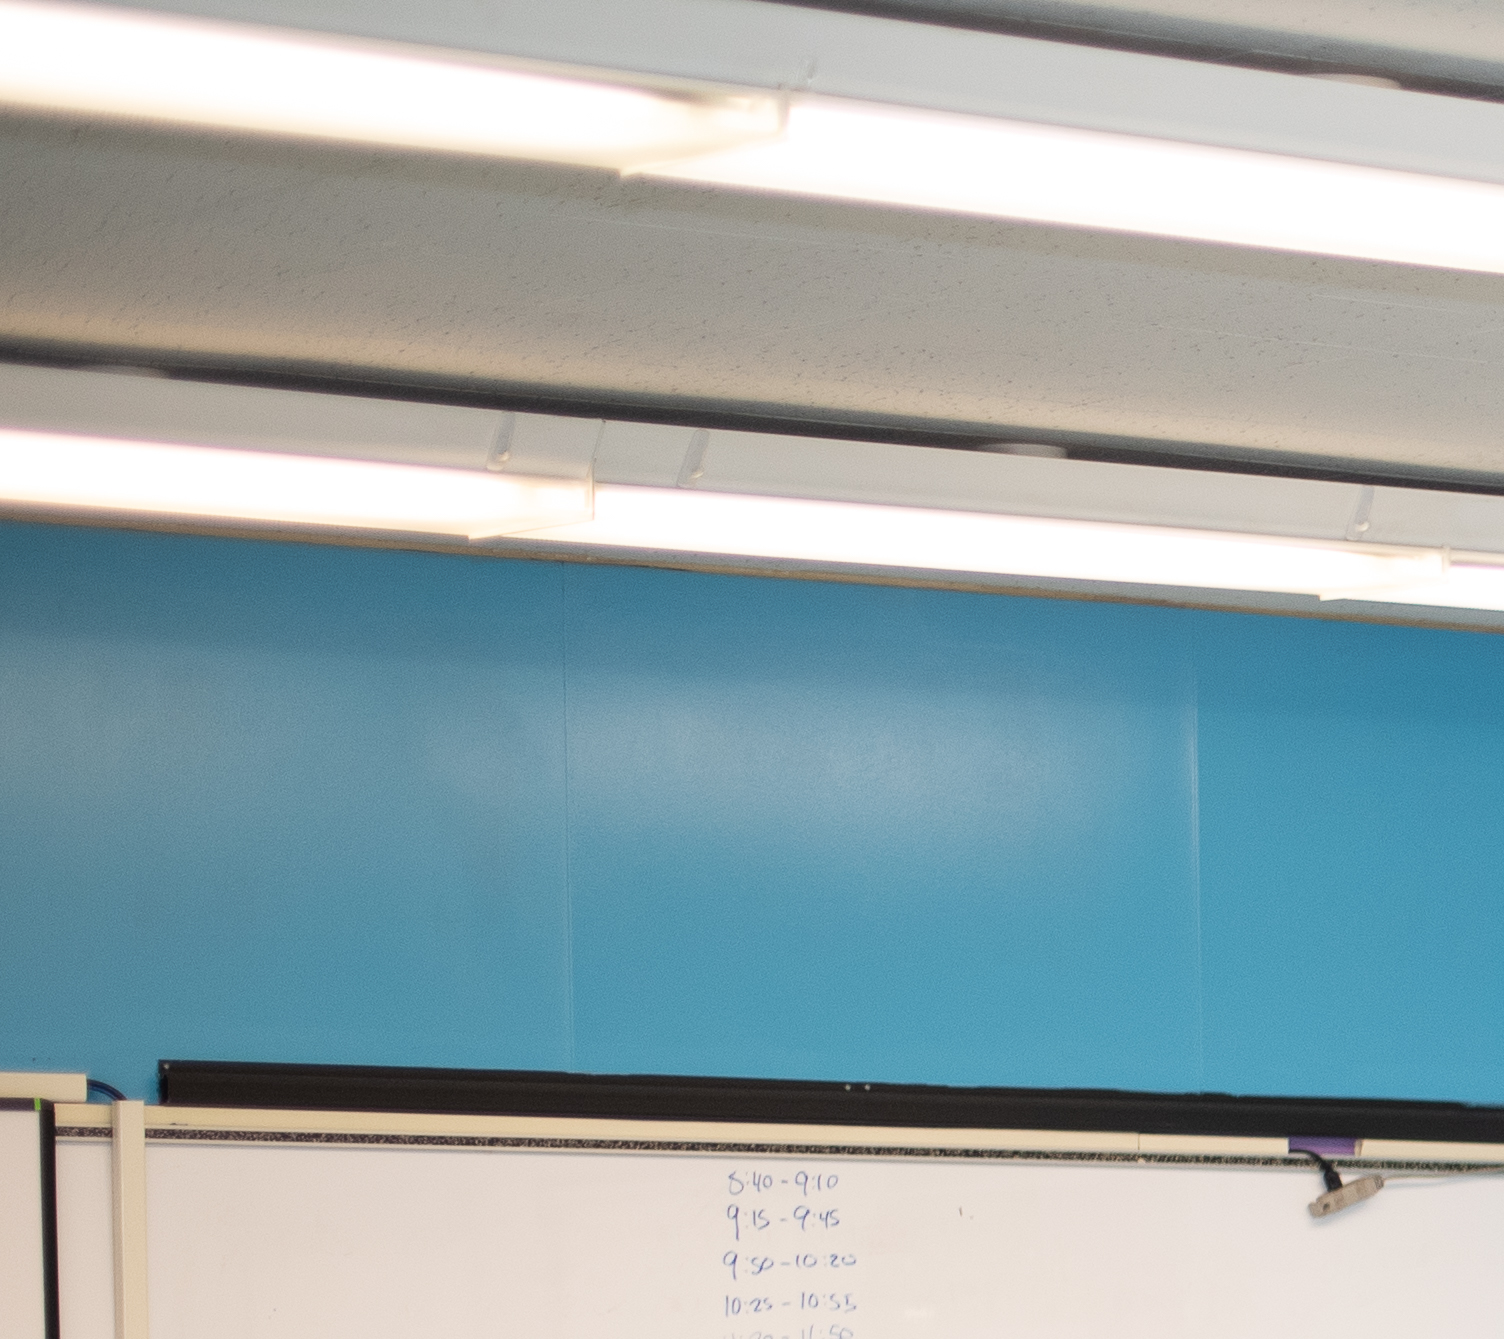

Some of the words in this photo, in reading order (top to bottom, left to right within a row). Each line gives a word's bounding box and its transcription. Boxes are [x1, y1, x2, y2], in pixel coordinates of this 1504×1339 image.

[728, 1170, 773, 1195] 8:40
[794, 1170, 839, 1197] 9:10
[726, 1203, 770, 1241] 9:15
[792, 1205, 840, 1231] 9:45
[722, 1250, 774, 1281] 9:50
[795, 1252, 857, 1269] 10:20
[725, 1294, 773, 1318] 10:25
[800, 1291, 857, 1314] 10:55
